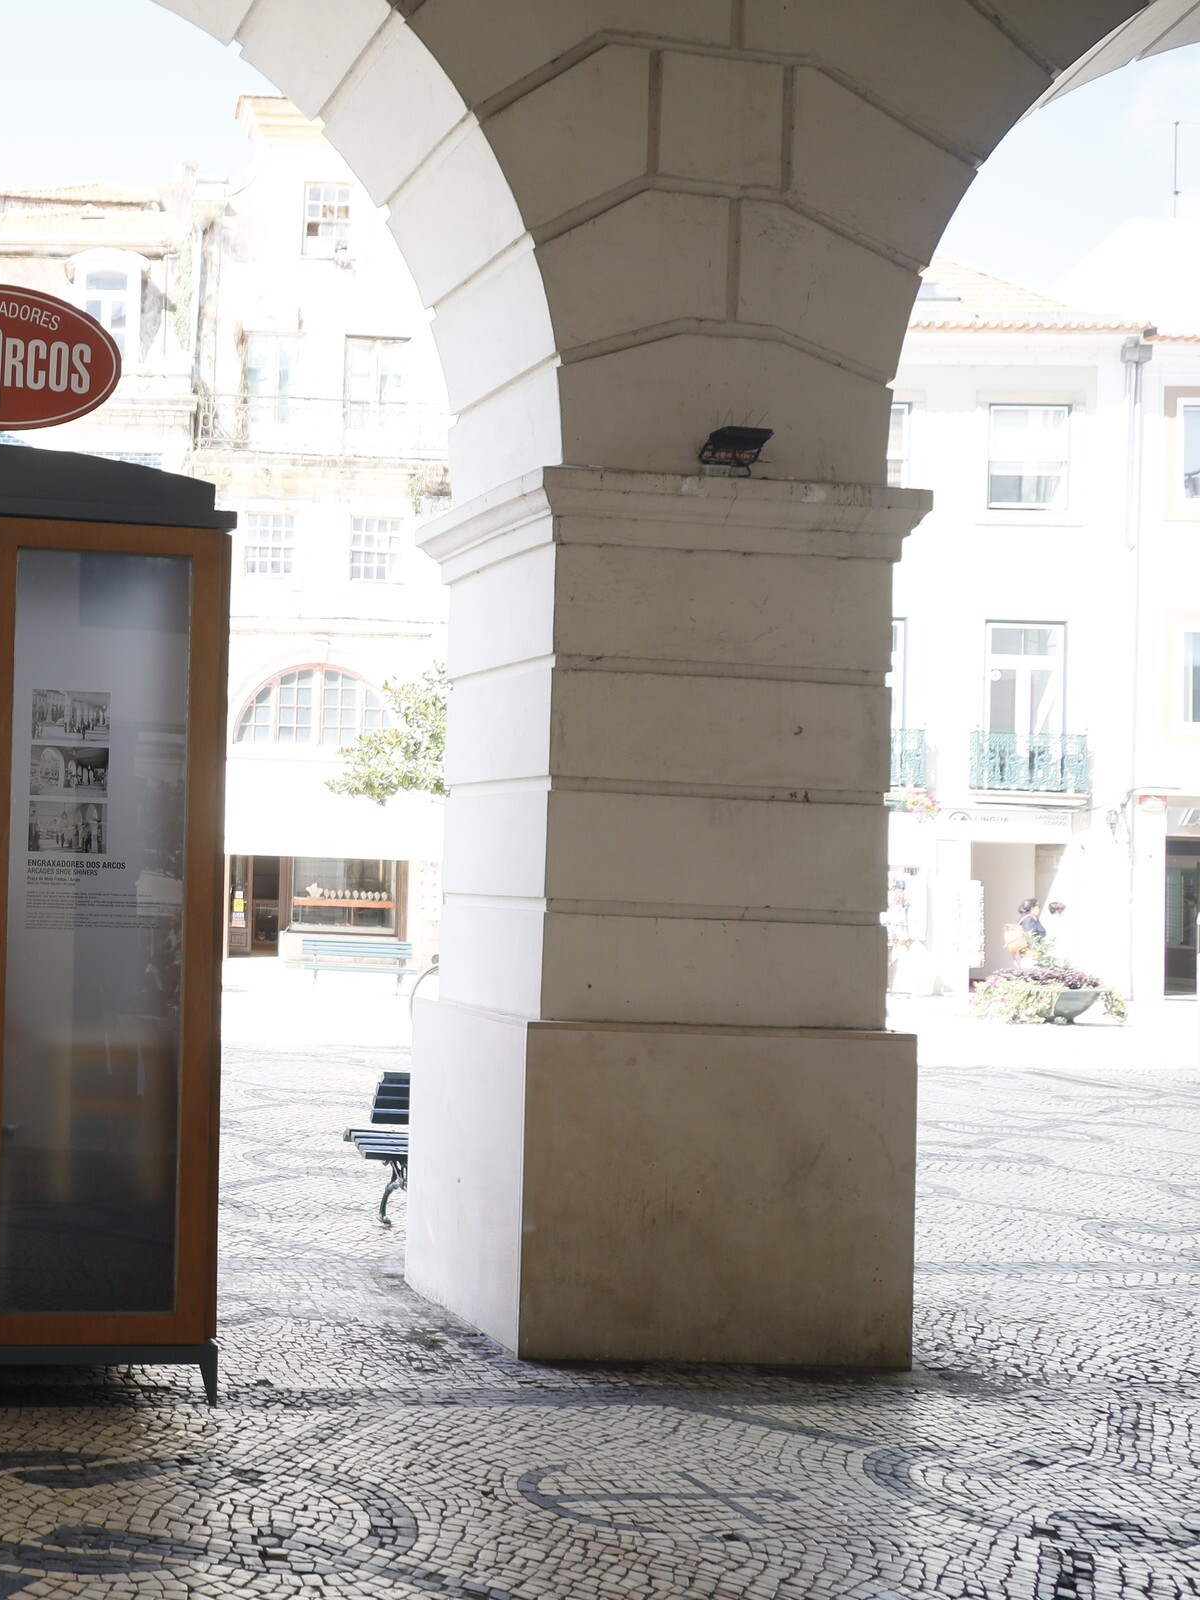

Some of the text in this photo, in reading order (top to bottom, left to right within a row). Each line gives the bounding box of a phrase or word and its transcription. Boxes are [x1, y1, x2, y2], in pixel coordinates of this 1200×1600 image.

[1034, 813, 1069, 821] LANGUAGE
[27, 859, 84, 868] ENGRAXADORES
[86, 861, 100, 869] DOS
